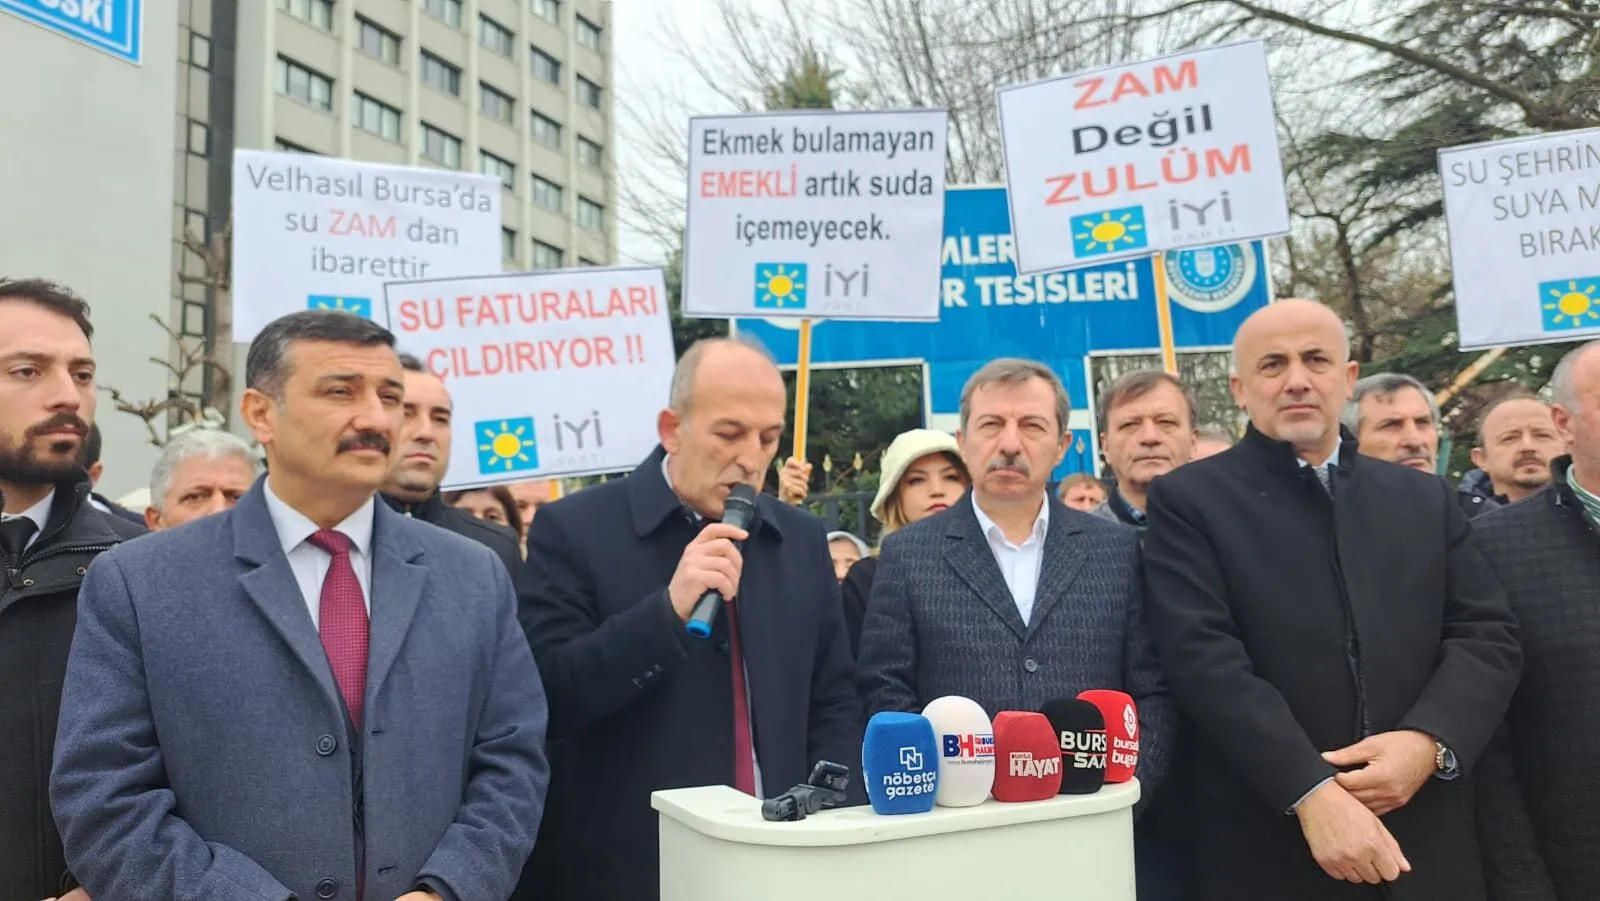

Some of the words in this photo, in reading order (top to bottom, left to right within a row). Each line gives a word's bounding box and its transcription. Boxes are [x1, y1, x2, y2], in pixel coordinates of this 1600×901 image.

[1073, 59, 1198, 110] ZAM
[703, 128, 784, 156] Ekmek
[793, 126, 934, 159] bulamayan
[1072, 104, 1213, 155] Değil
[247, 164, 363, 198] Velhasıl
[701, 163, 797, 198] EMEKLİ
[805, 170, 860, 197] artık
[869, 169, 933, 196] suda
[1045, 144, 1252, 206] ZULÜM
[1451, 159, 1488, 187] SU
[1493, 189, 1569, 221] SUYA
[285, 212, 318, 233] su
[329, 209, 397, 239] ZAM
[407, 218, 459, 245] dan
[736, 214, 890, 247] içemeyecek.
[312, 247, 430, 279] ibarettir
[825, 263, 870, 298] İYİ
[399, 299, 445, 332] SU
[456, 286, 658, 328] FATURALARI
[428, 336, 617, 381] ÇILDIRIYOR
[625, 335, 645, 364] !!
[553, 410, 603, 451] İYİ
[943, 735, 974, 757] BH
[1010, 757, 1060, 779] HAYAT
[886, 783, 934, 800] gazete
